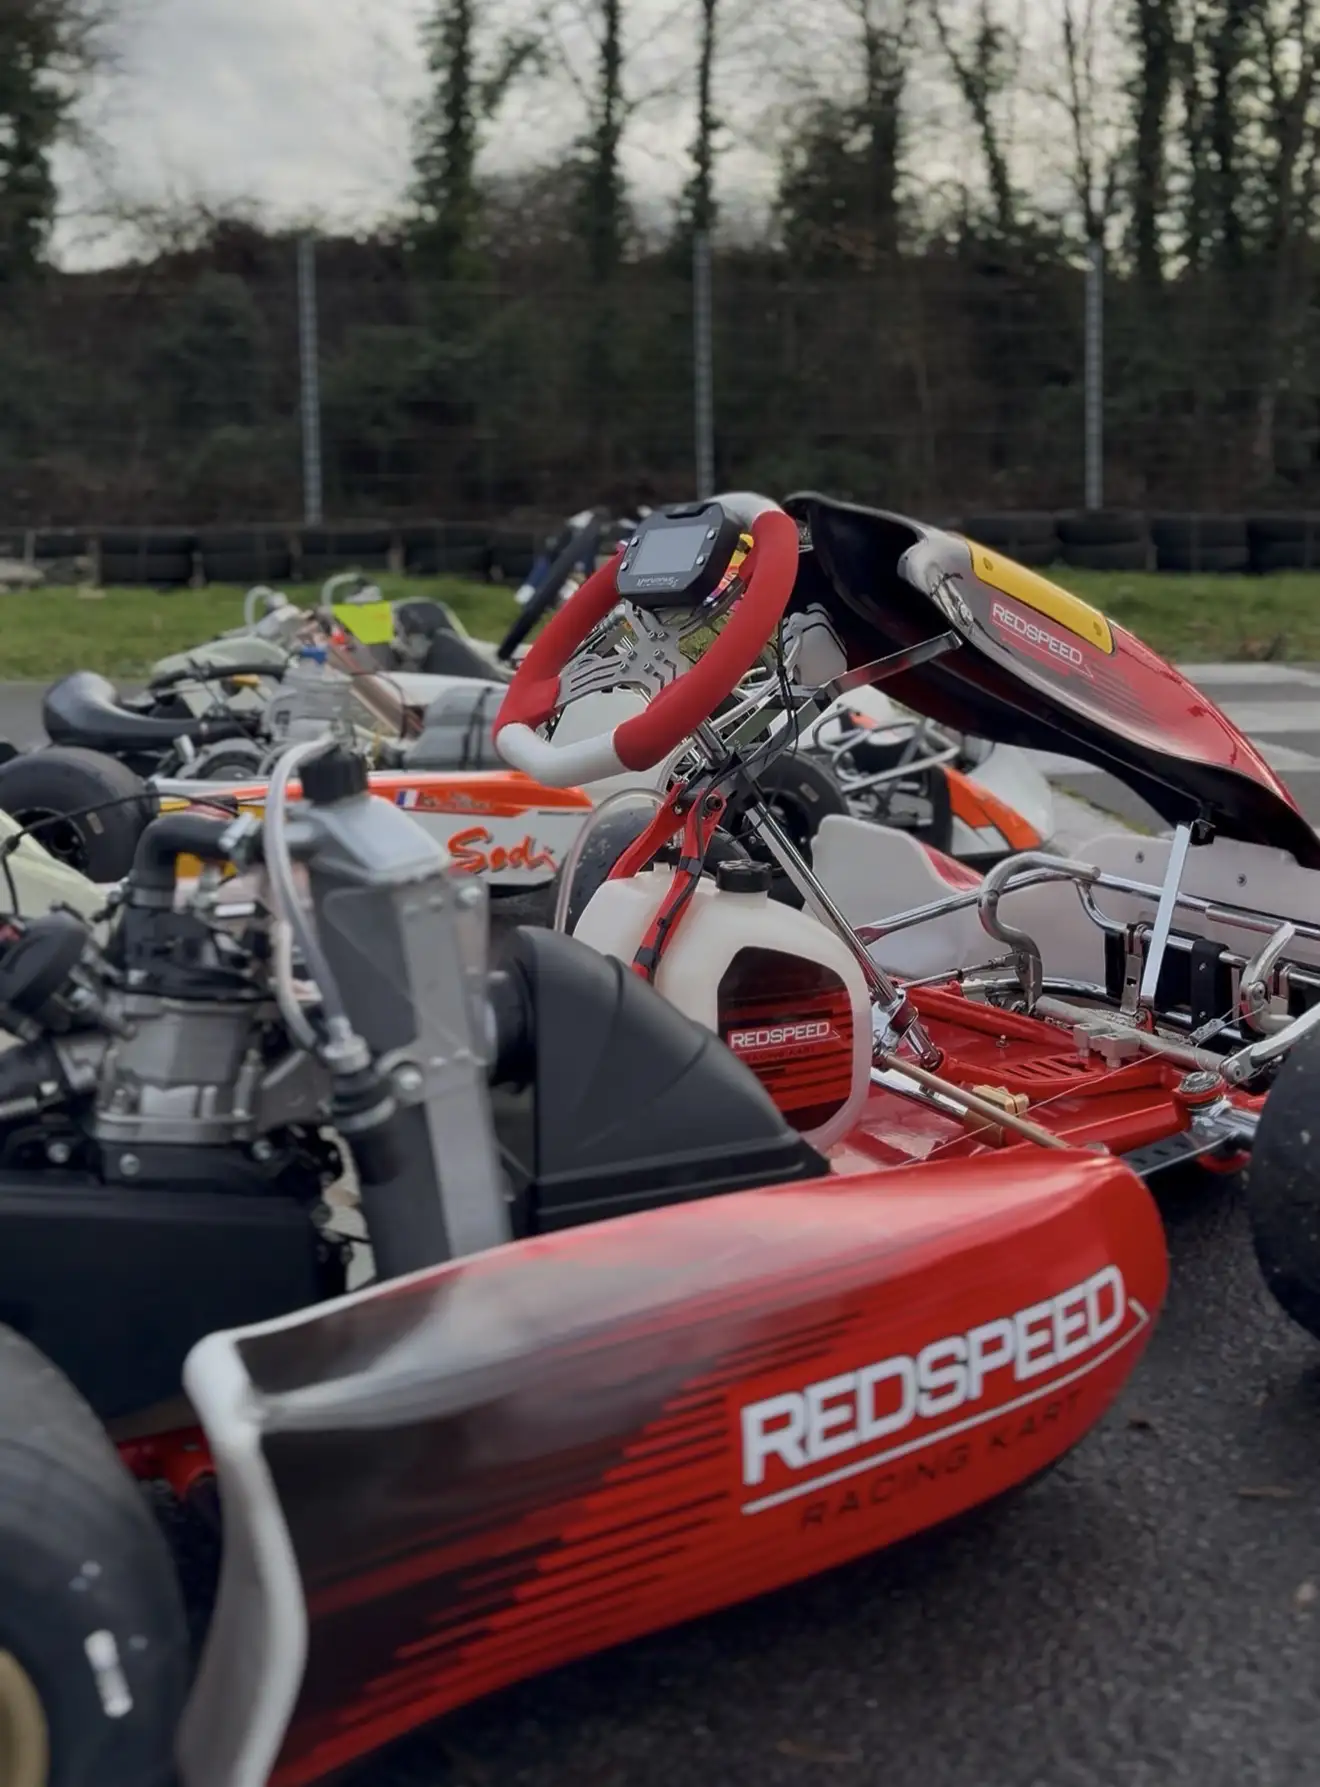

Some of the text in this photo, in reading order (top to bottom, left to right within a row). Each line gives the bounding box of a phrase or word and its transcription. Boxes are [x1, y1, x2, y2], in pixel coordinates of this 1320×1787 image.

[992, 602, 1083, 665] REDSPEED
[731, 1021, 830, 1049] REDSPEED
[741, 1265, 1126, 1486] REDSPEED
[803, 1389, 1082, 1530] RACING KART
